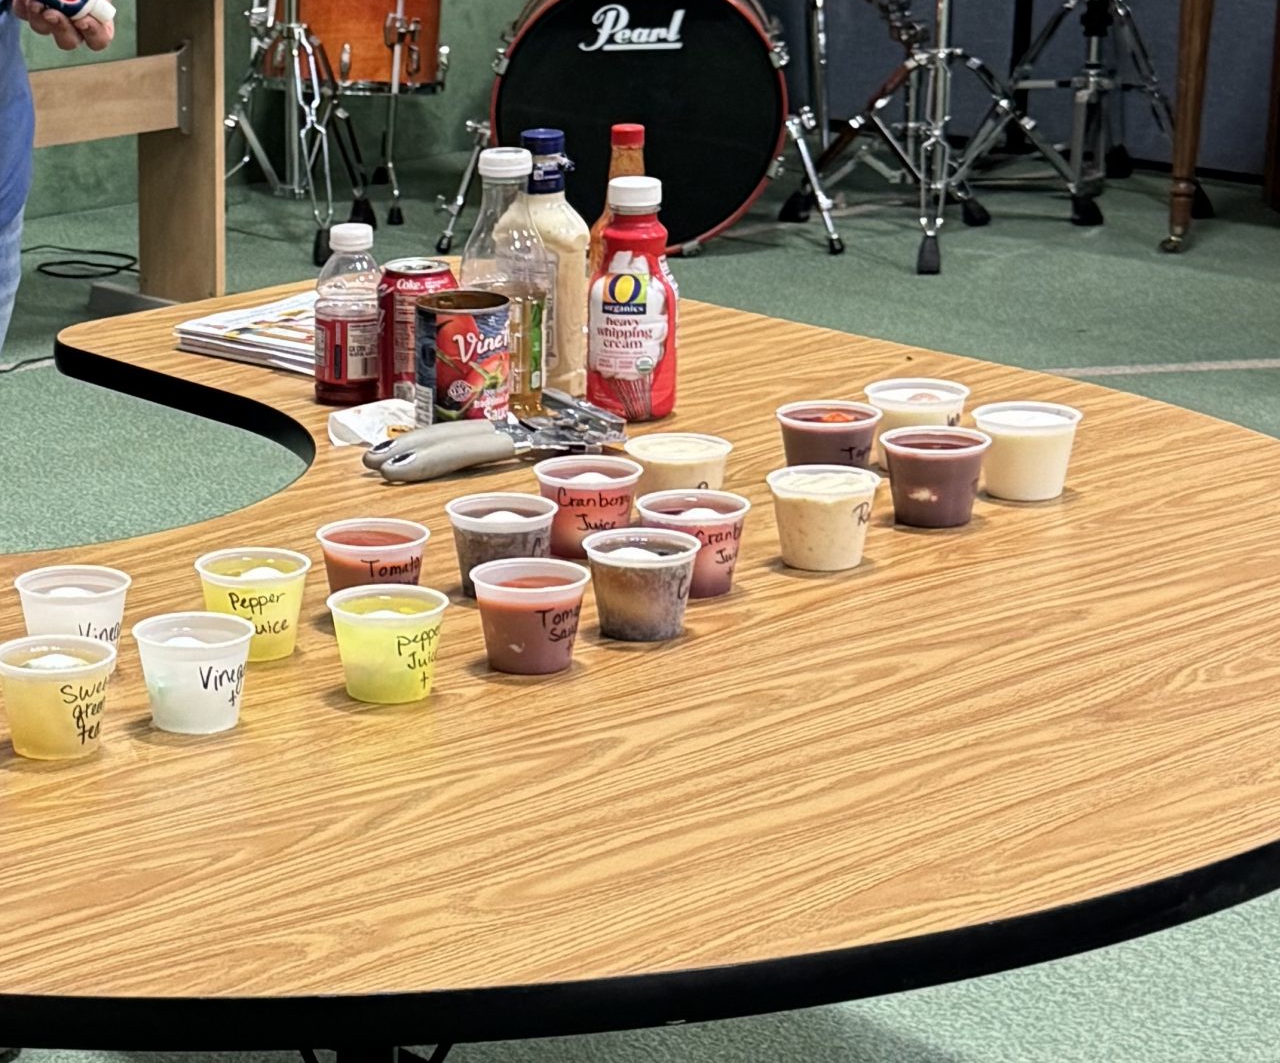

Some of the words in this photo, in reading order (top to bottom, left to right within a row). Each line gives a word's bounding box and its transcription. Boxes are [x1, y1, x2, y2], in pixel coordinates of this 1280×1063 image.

[578, 4, 686, 52] Pearl
[604, 305, 644, 313] organics
[606, 316, 639, 326] heavy
[597, 326, 653, 339] whipping
[603, 339, 643, 348] cream
[575, 513, 617, 531] Juice
[228, 591, 286, 616] Pepper
[254, 618, 290, 635] uice
